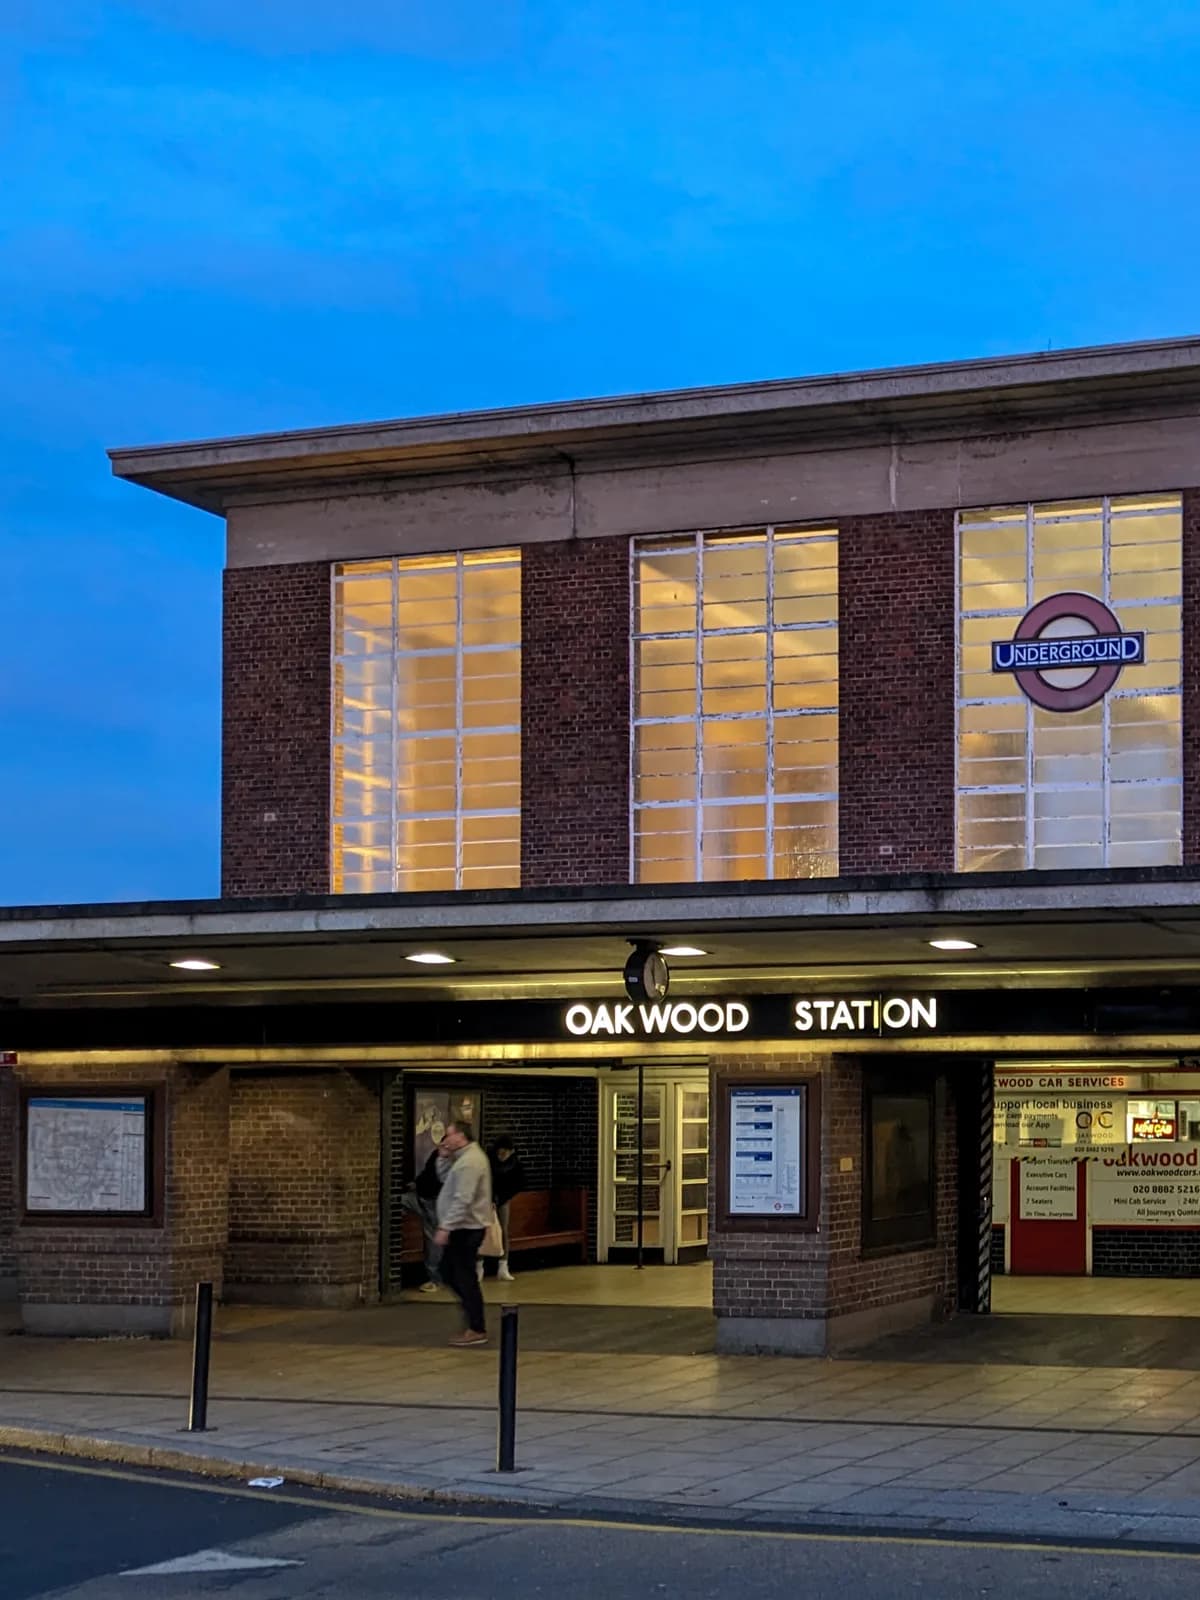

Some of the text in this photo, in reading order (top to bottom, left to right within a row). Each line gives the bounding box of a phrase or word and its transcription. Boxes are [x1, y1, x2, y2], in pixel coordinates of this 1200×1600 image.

[995, 637, 1140, 667] UNDERGROUND
[565, 998, 938, 1035] OAKWOOD STATION
[1039, 1078, 1063, 1087] CAR
[1068, 1077, 1125, 1087] SERVICES
[1033, 1099, 1059, 1109] local
[1063, 1098, 1113, 1109] business
[1035, 1121, 1050, 1130] App
[1133, 1185, 1200, 1193] 020 8882 5216
[1147, 1208, 1176, 1217] Journeys
